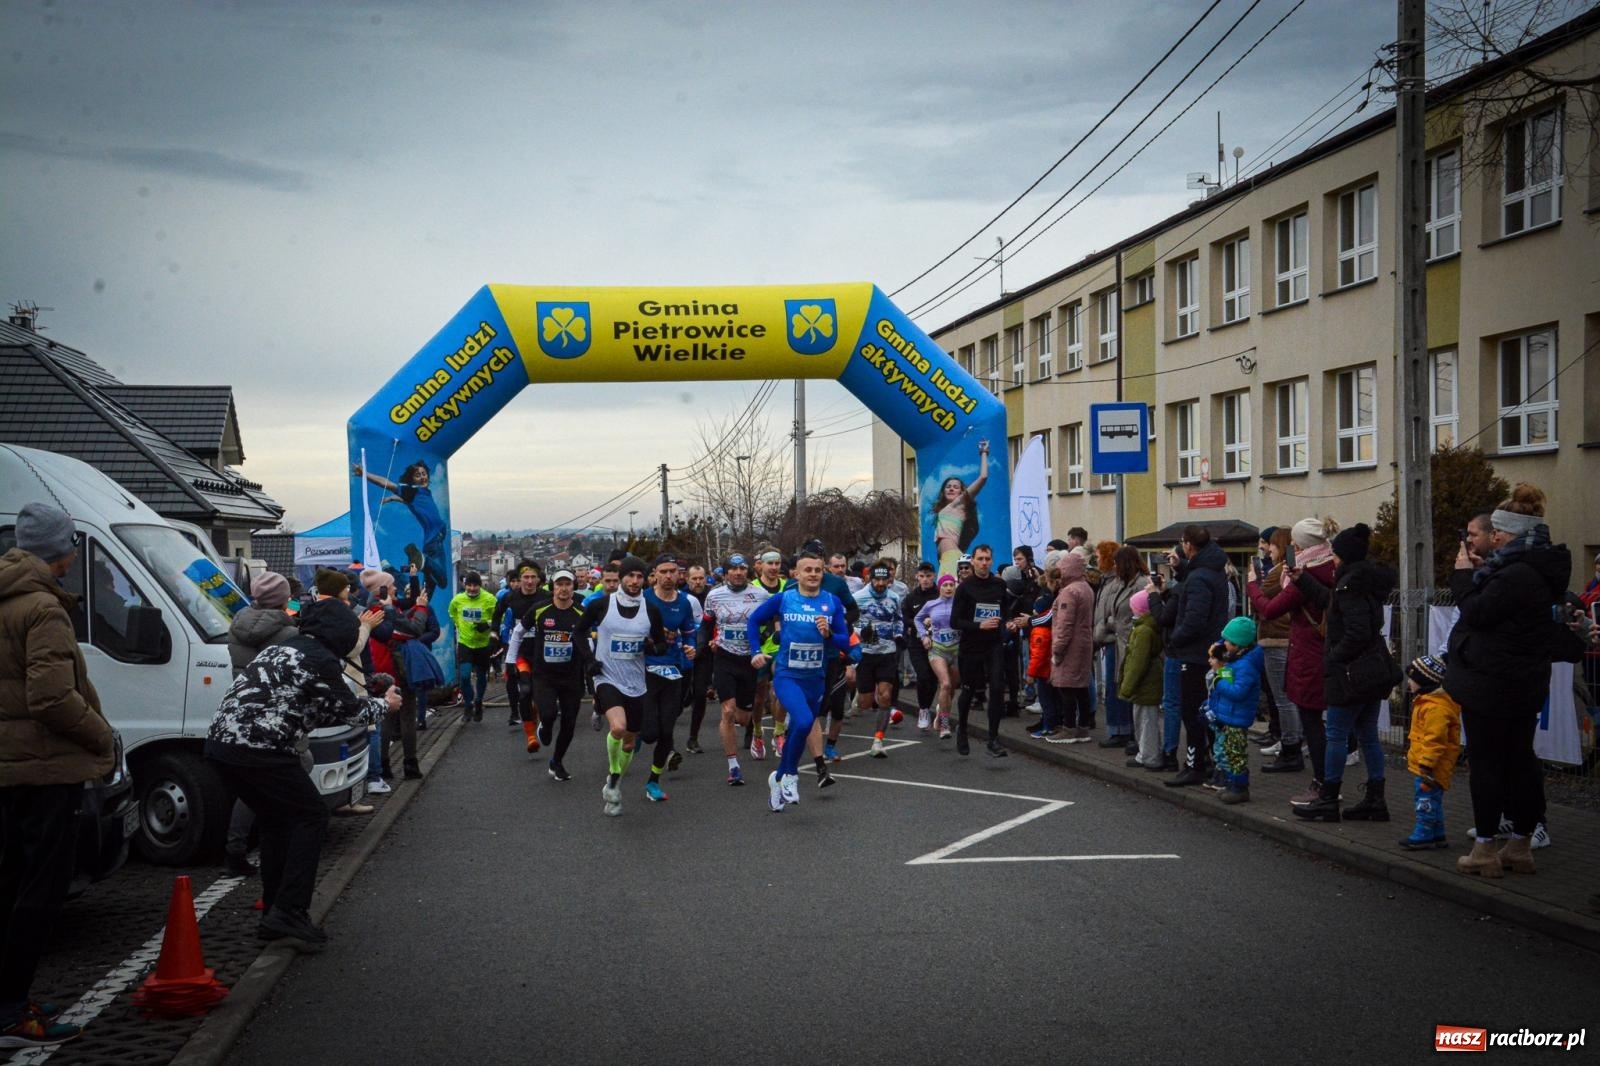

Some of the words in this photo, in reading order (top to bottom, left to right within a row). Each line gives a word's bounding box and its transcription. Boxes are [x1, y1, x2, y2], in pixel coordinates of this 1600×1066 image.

[638, 300, 739, 317] Gmina
[613, 319, 767, 340] Pietrowice
[633, 343, 746, 362] Wielkie
[390, 368, 452, 424] Gmina
[445, 321, 497, 371] ludzi
[876, 319, 931, 374] Gmina
[929, 367, 978, 414] ludzi
[415, 347, 515, 442] aktywnych
[860, 343, 957, 432] aktywnych
[980, 609, 997, 618] 220
[549, 647, 567, 656] 155
[617, 642, 639, 652] 134
[796, 650, 818, 661] 114
